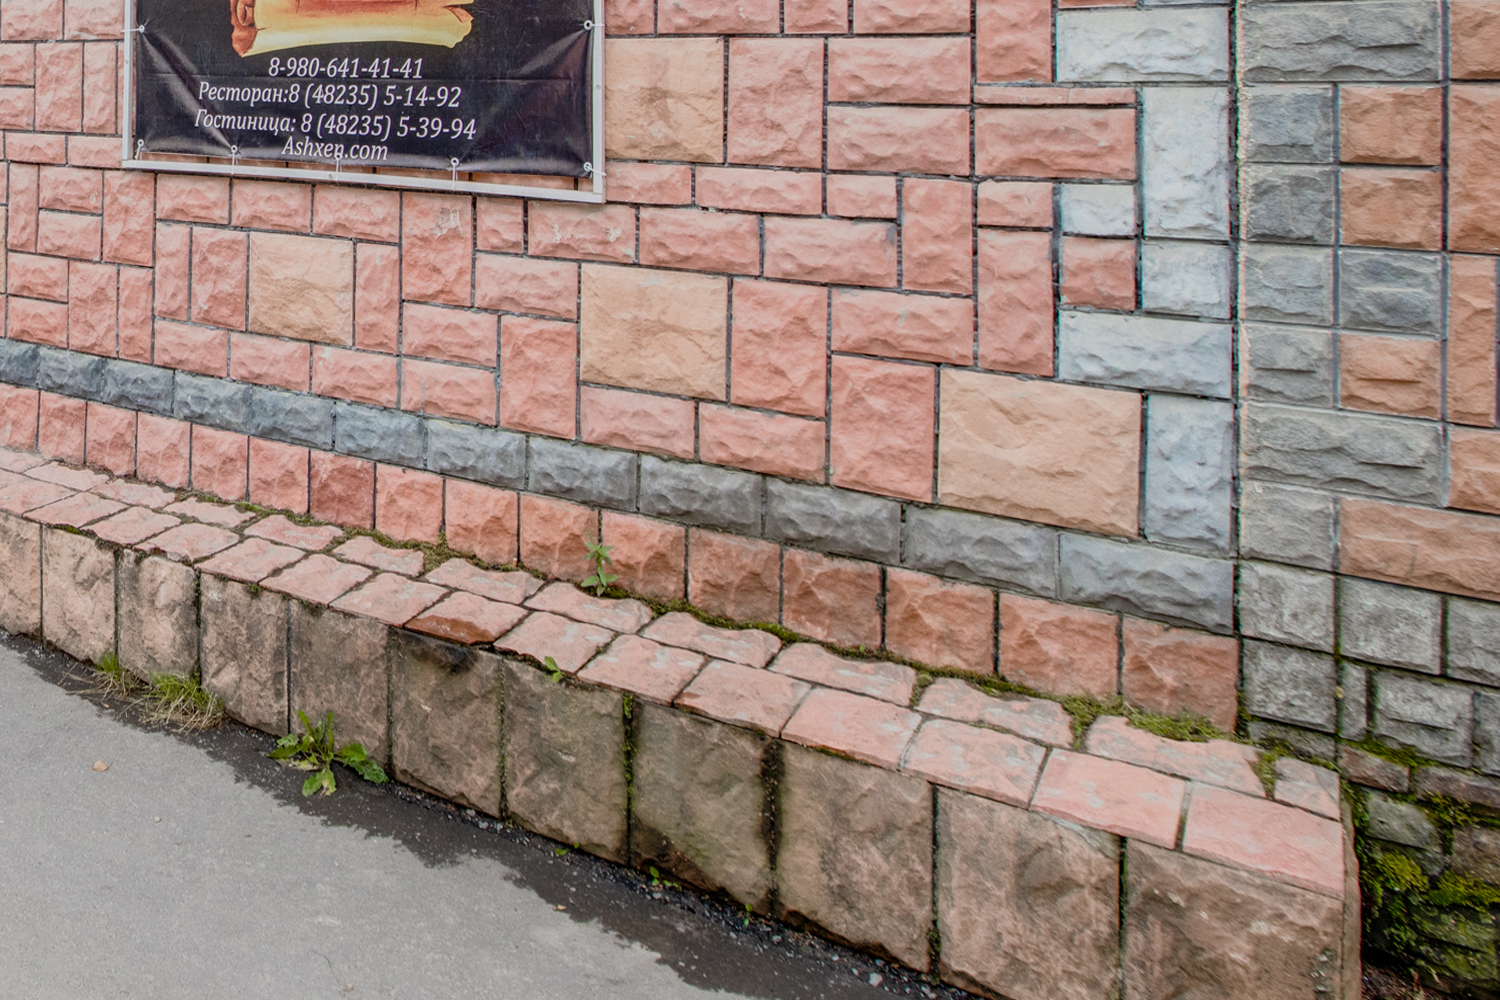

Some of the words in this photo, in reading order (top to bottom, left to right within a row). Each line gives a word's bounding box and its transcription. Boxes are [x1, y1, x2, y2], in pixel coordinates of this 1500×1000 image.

[268, 57, 423, 78] 8-980-641-41-41
[304, 83, 379, 111] (48235)
[384, 85, 462, 107] 5-14-92
[194, 109, 297, 134] Гостиница:
[301, 113, 312, 132] 8
[316, 113, 392, 142] (48235)
[397, 116, 476, 140] 5-39-94
[281, 136, 388, 160] Ashxen.com
